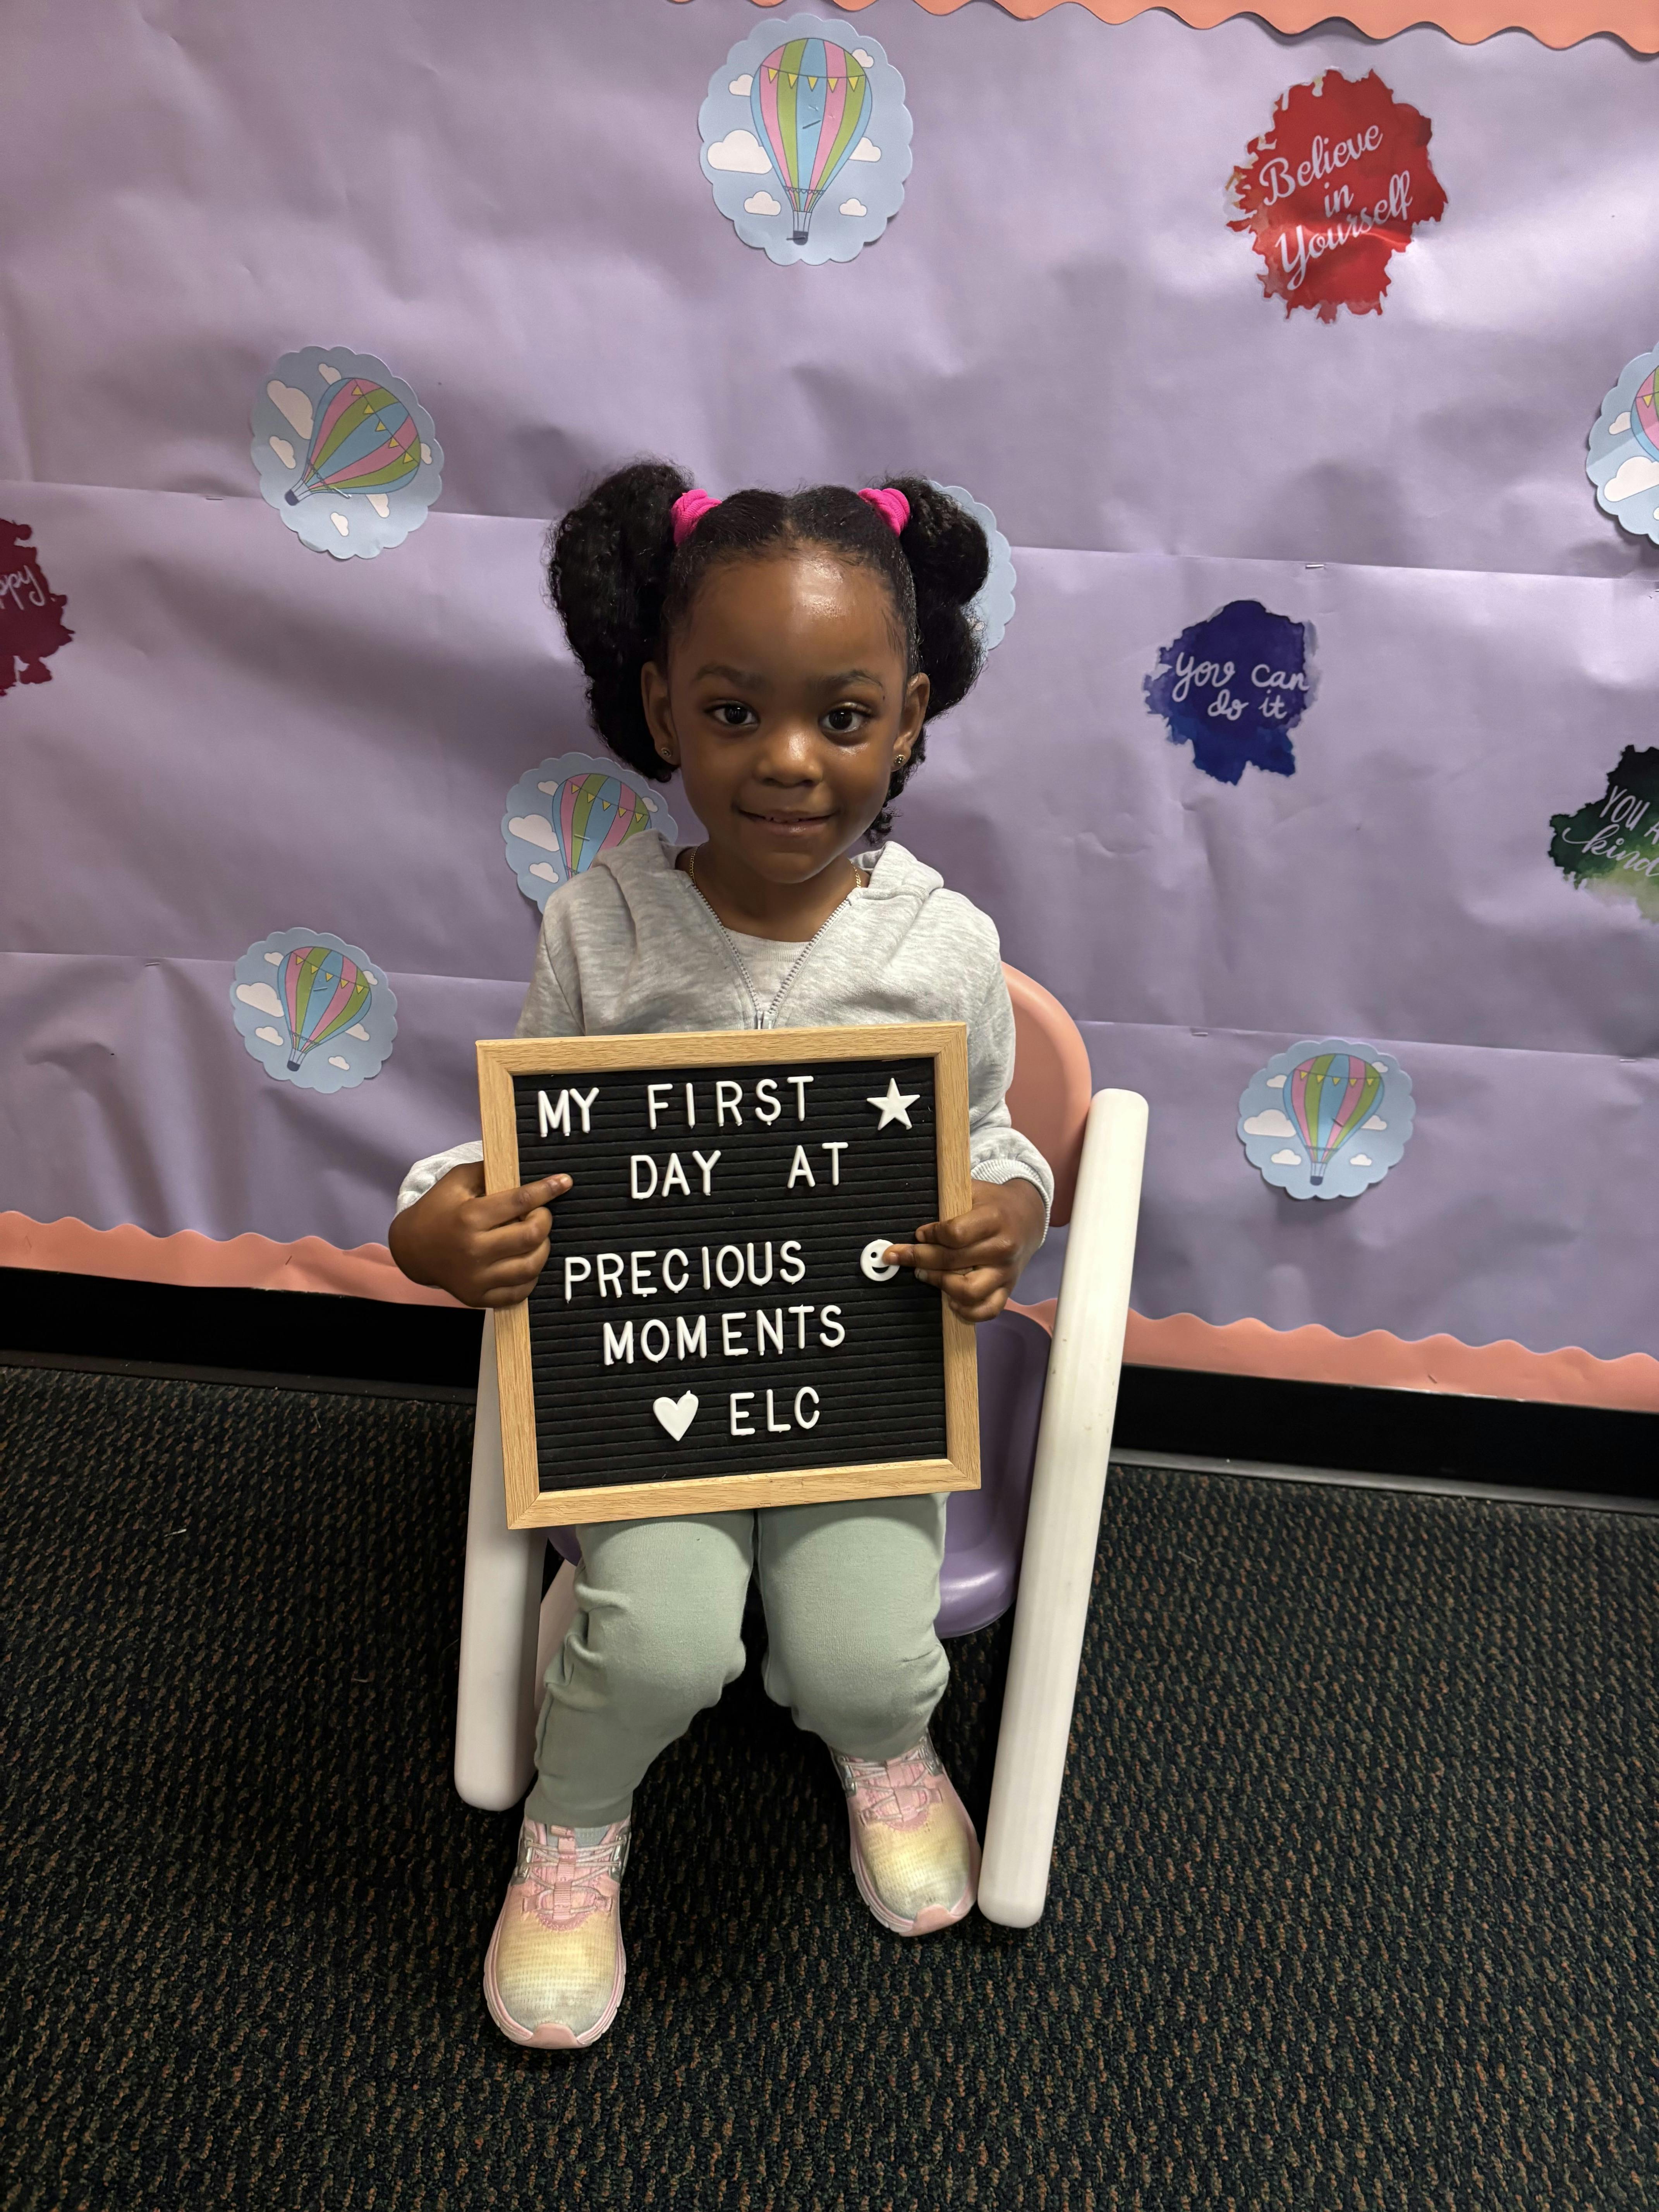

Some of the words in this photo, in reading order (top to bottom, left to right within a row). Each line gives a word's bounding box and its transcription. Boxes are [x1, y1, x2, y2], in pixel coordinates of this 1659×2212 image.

[1259, 125, 1384, 206] Believe
[1324, 181, 1354, 218] in
[1274, 170, 1413, 291] Yourself
[1207, 689, 1249, 721] do
[1258, 689, 1288, 720] it
[1599, 785, 1651, 831] YOU
[538, 1087, 600, 1138] MY
[647, 1075, 814, 1130] FIRST
[630, 1149, 721, 1200] DAY
[787, 1141, 849, 1189] AT
[564, 1240, 806, 1302] PRECIOUS
[603, 1304, 846, 1366] MOMENTS
[730, 1386, 820, 1436] ELC
